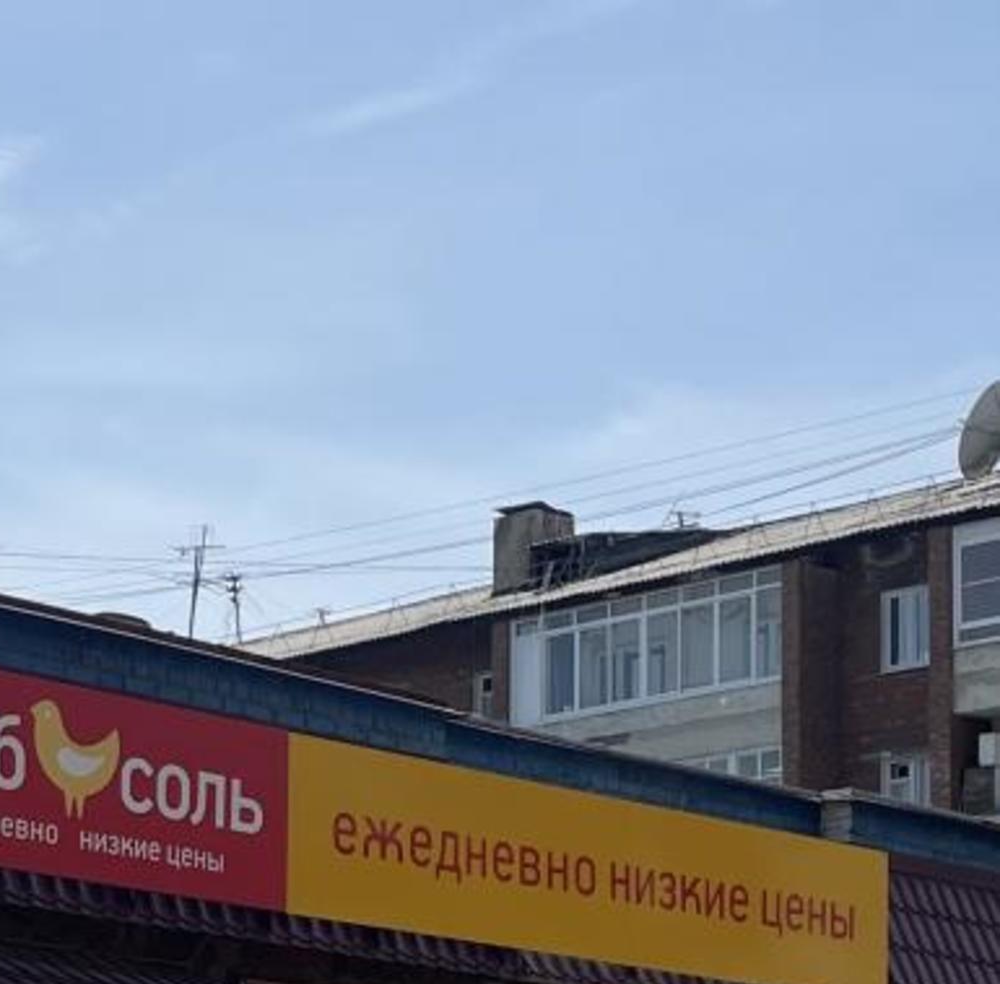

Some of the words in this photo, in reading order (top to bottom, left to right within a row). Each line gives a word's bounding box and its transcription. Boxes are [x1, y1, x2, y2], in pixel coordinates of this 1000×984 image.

[120, 757, 264, 834] соль
[79, 830, 162, 862] низкие
[166, 844, 225, 873] цены
[332, 811, 597, 897] ежедневно
[609, 860, 751, 924] низкие
[760, 889, 856, 941] цены
